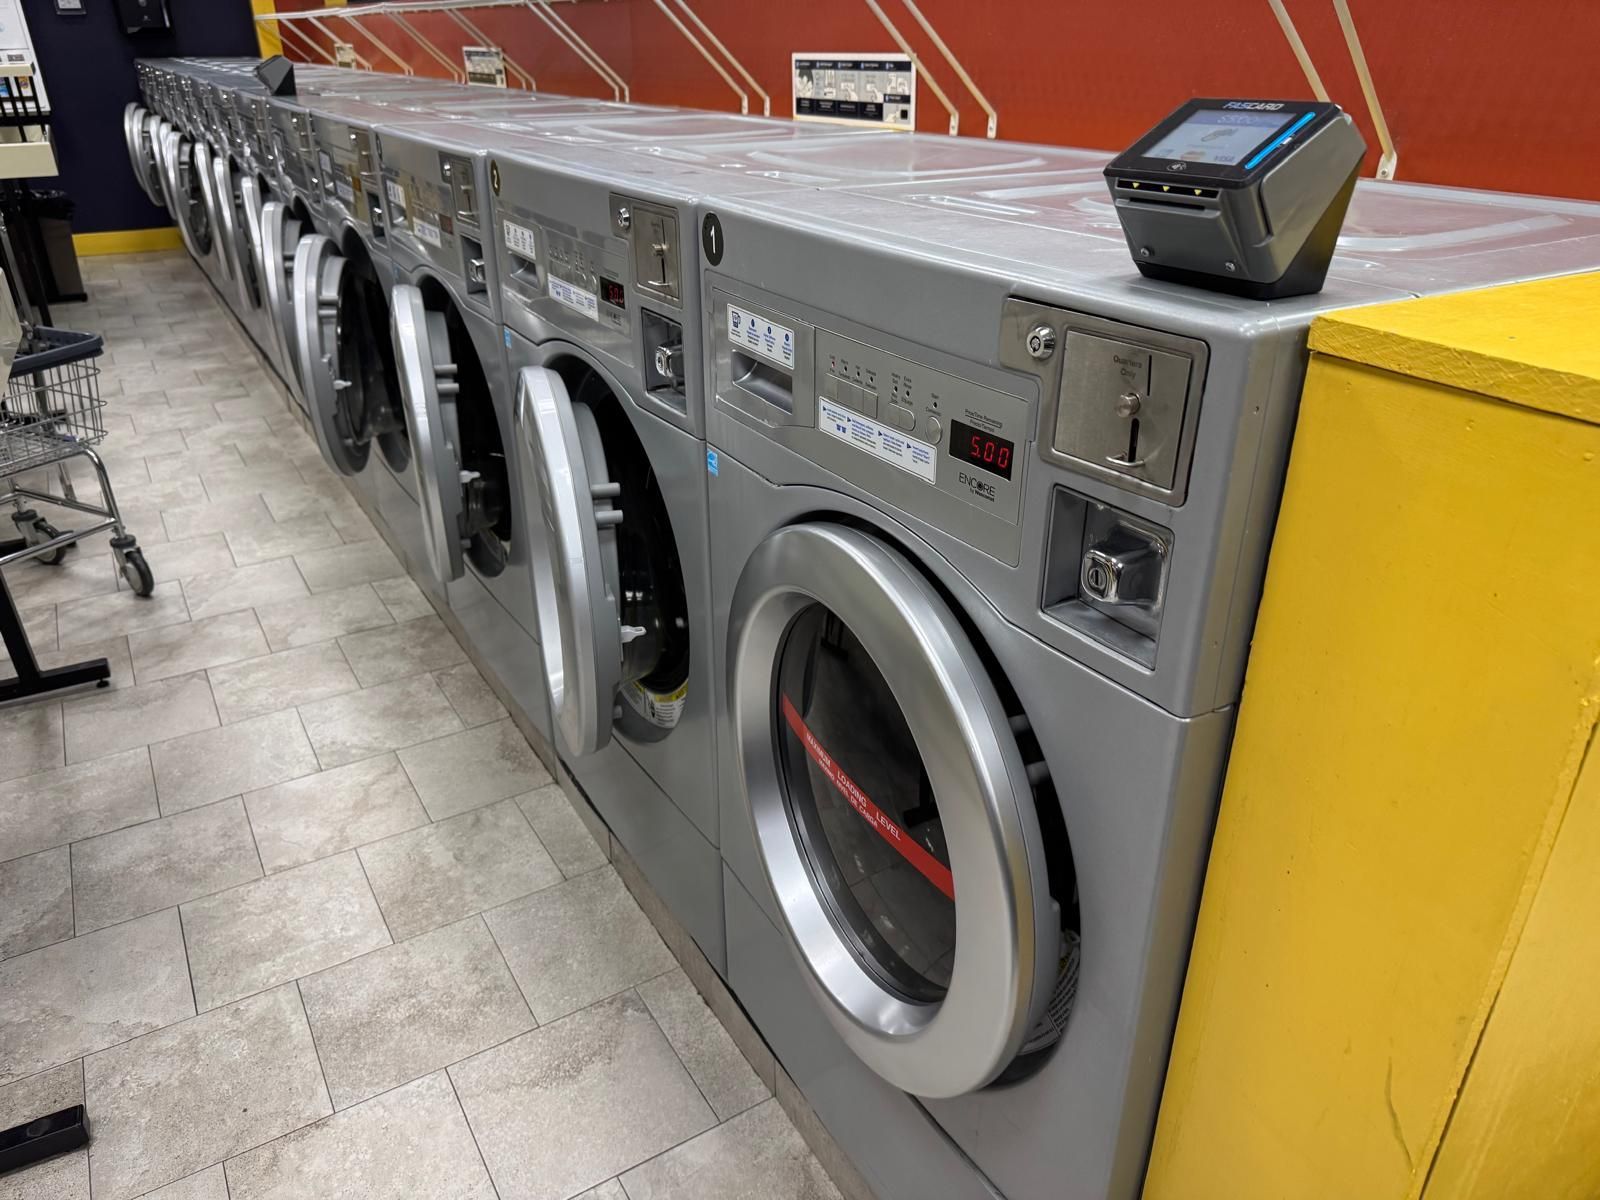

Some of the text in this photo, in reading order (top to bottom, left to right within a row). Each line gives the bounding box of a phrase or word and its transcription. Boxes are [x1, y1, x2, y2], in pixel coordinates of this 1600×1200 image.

[1222, 101, 1285, 111] FASCARD
[710, 225, 716, 254] 1
[1120, 367, 1137, 380] Only
[958, 471, 996, 497] ENCORE
[837, 769, 867, 808] LOADING
[875, 811, 901, 841] LEVEL
[859, 805, 878, 829] CARGA
